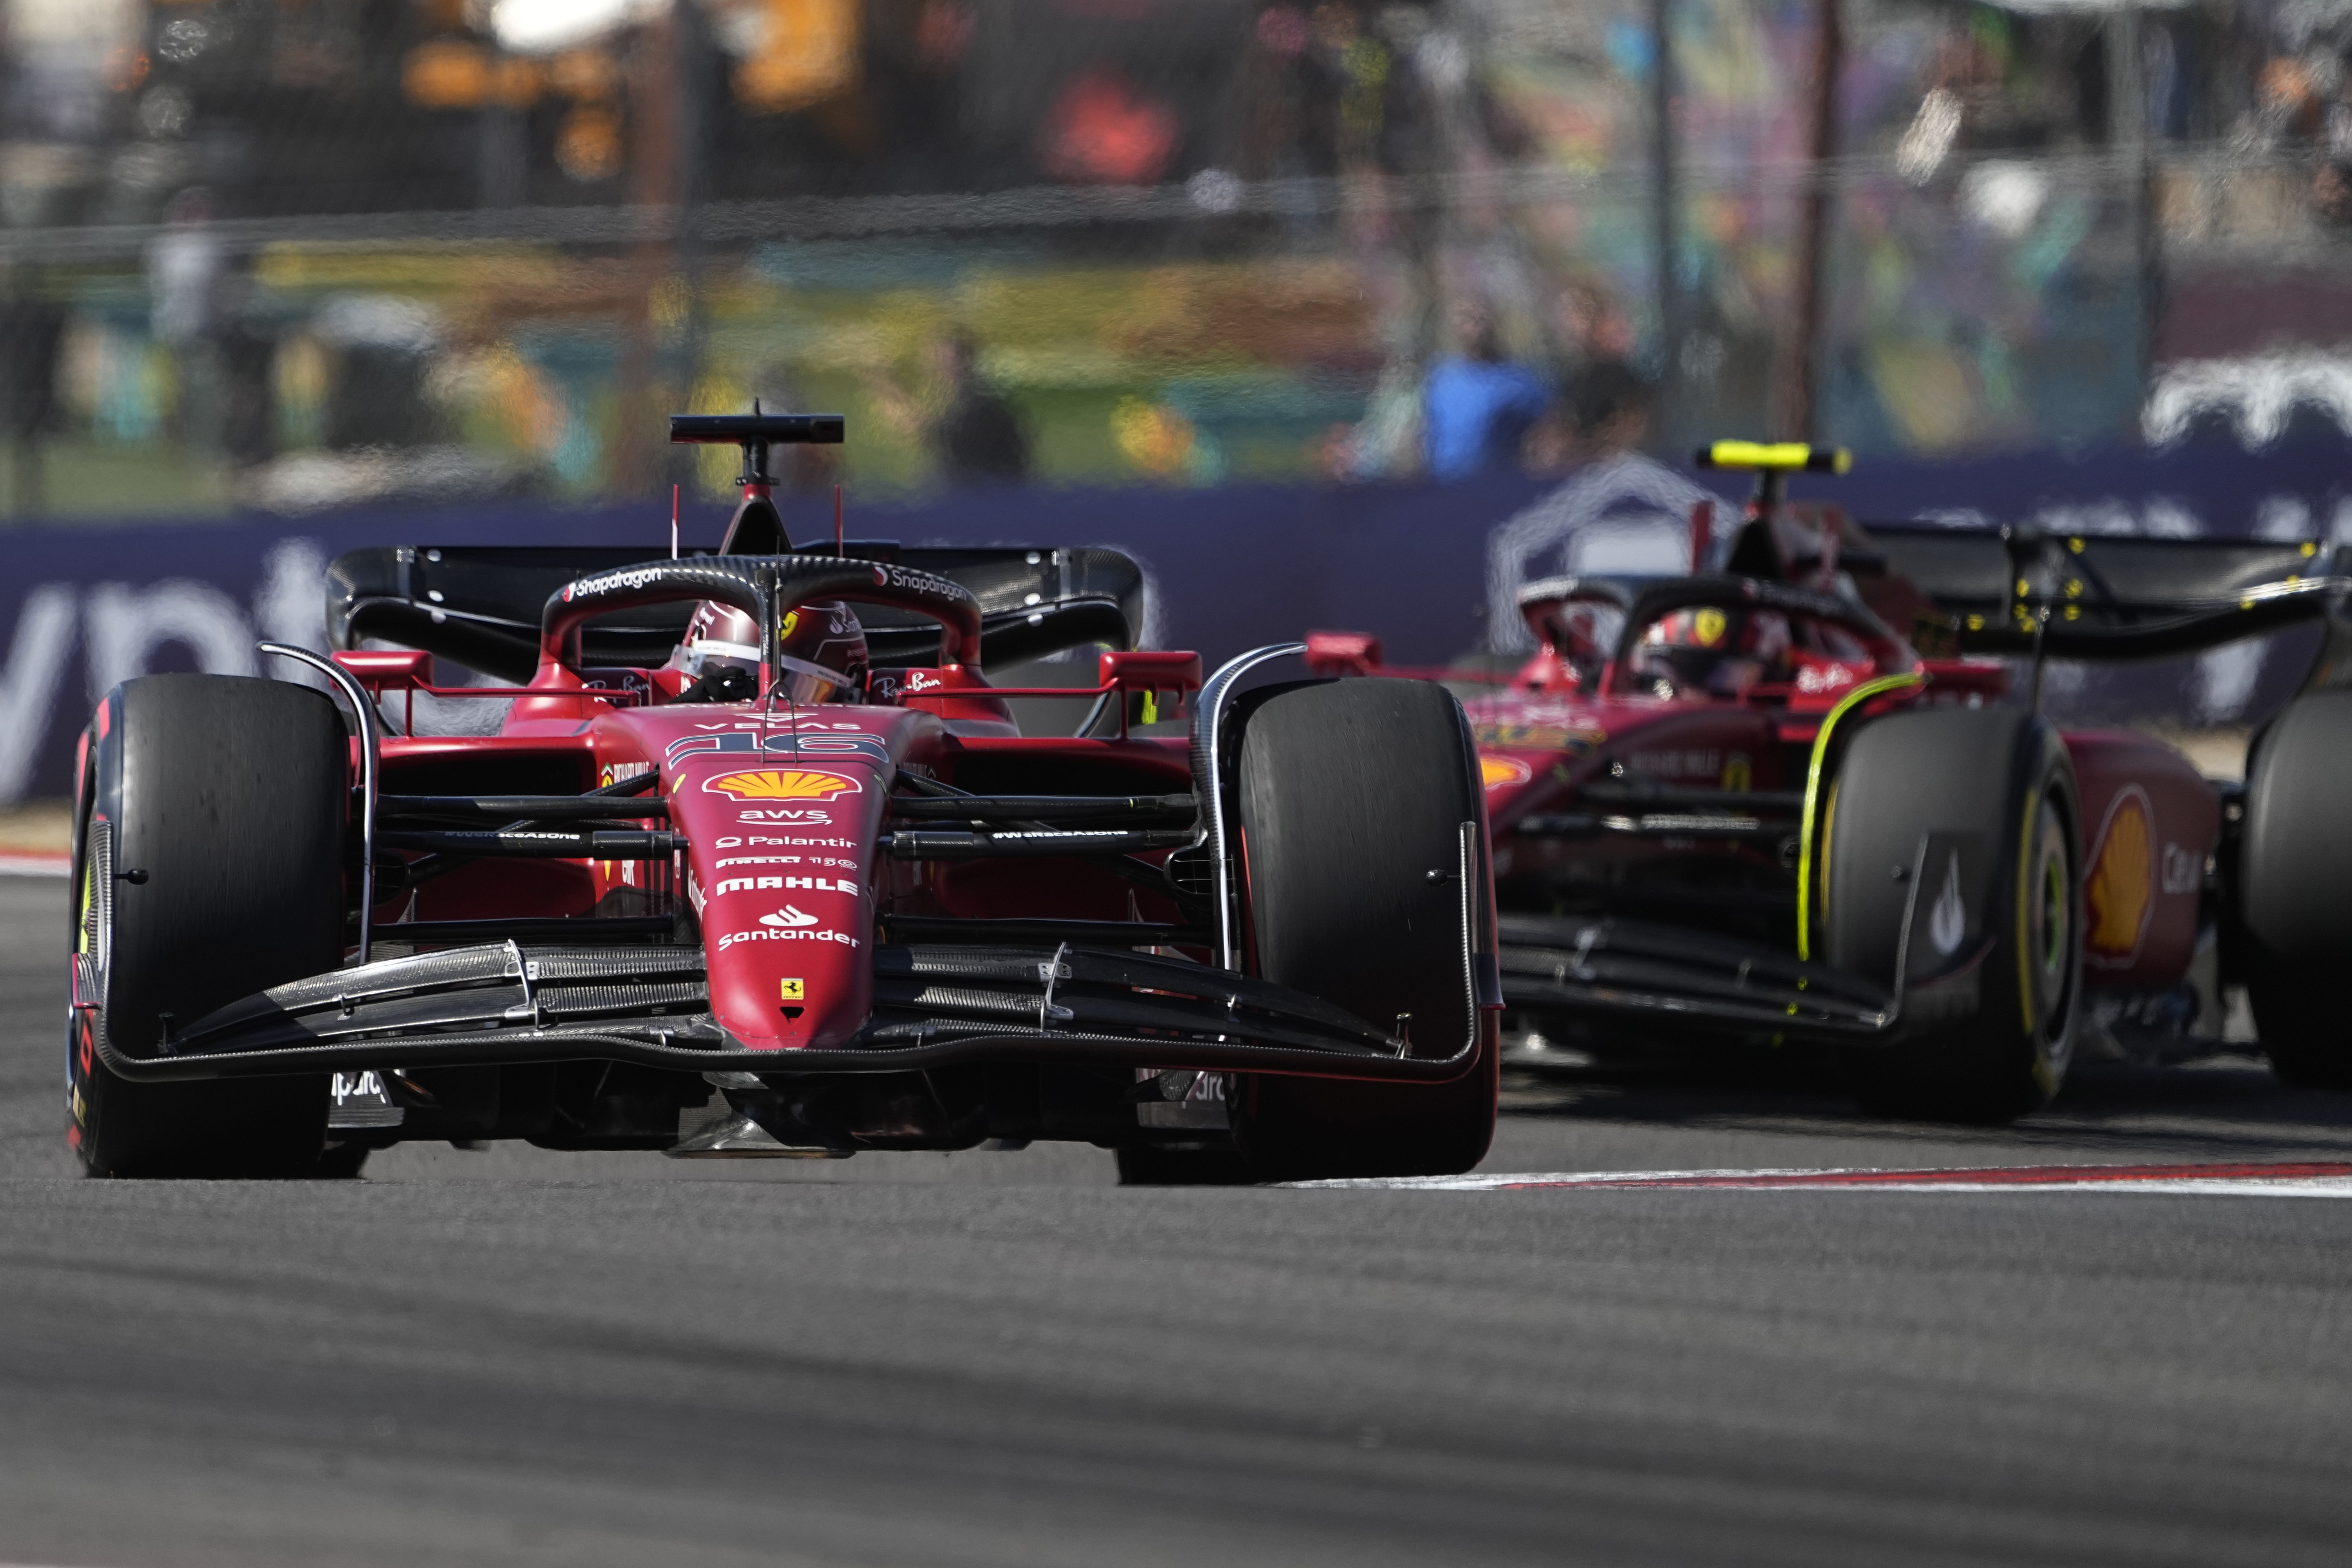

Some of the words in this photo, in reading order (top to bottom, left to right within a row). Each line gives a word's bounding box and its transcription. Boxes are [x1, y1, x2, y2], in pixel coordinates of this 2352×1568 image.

[576, 567, 662, 597] Snapdragon
[891, 569, 967, 601] Snapdragon
[665, 732, 889, 770] 16
[739, 810, 828, 820] aws
[748, 836, 857, 848] Palantir
[715, 855, 801, 869] PIRELLI
[716, 876, 858, 897] MAHLE
[718, 928, 860, 952] Santander
